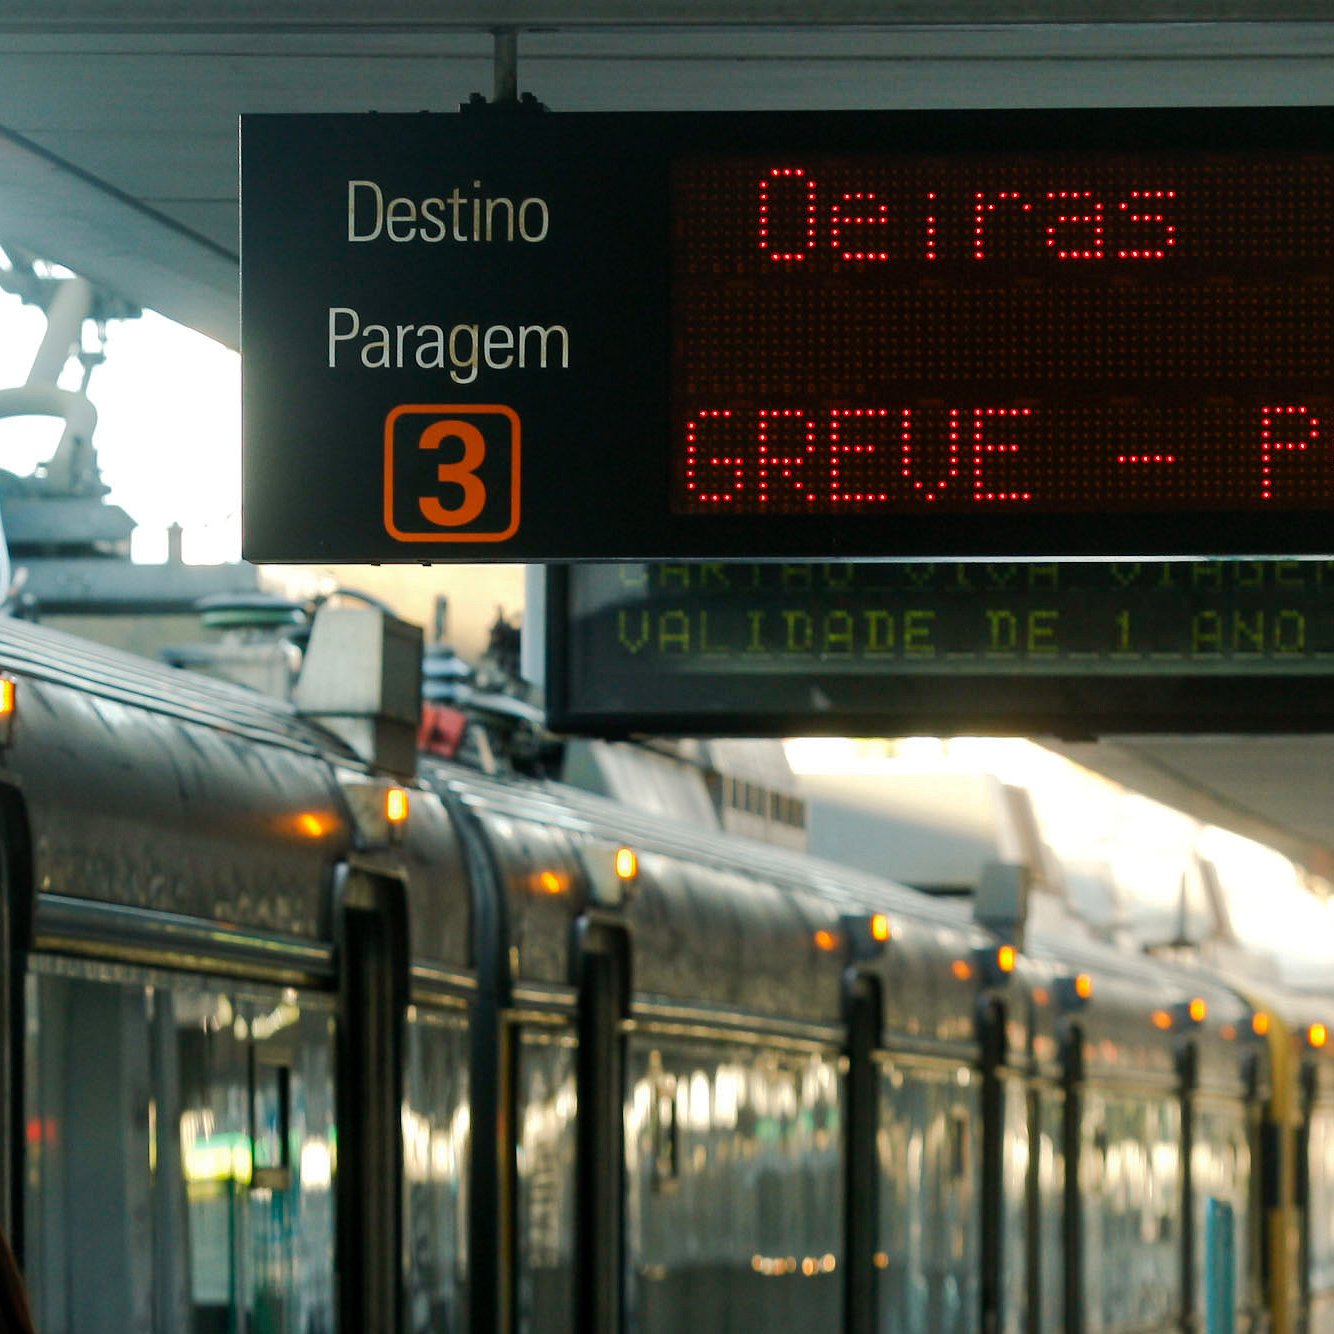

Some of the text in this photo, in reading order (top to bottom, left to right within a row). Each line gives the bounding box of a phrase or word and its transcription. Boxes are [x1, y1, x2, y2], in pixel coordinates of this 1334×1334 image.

[348, 180, 549, 243] Destino
[758, 168, 1177, 262] Oeiras
[328, 307, 569, 385] Paragem
[417, 420, 487, 527] 3
[685, 407, 1032, 502] GREVE
[618, 608, 936, 654] VALIDADE
[986, 608, 1060, 652] DE
[1113, 609, 1132, 651] 1
[1192, 608, 1307, 652] ANO
